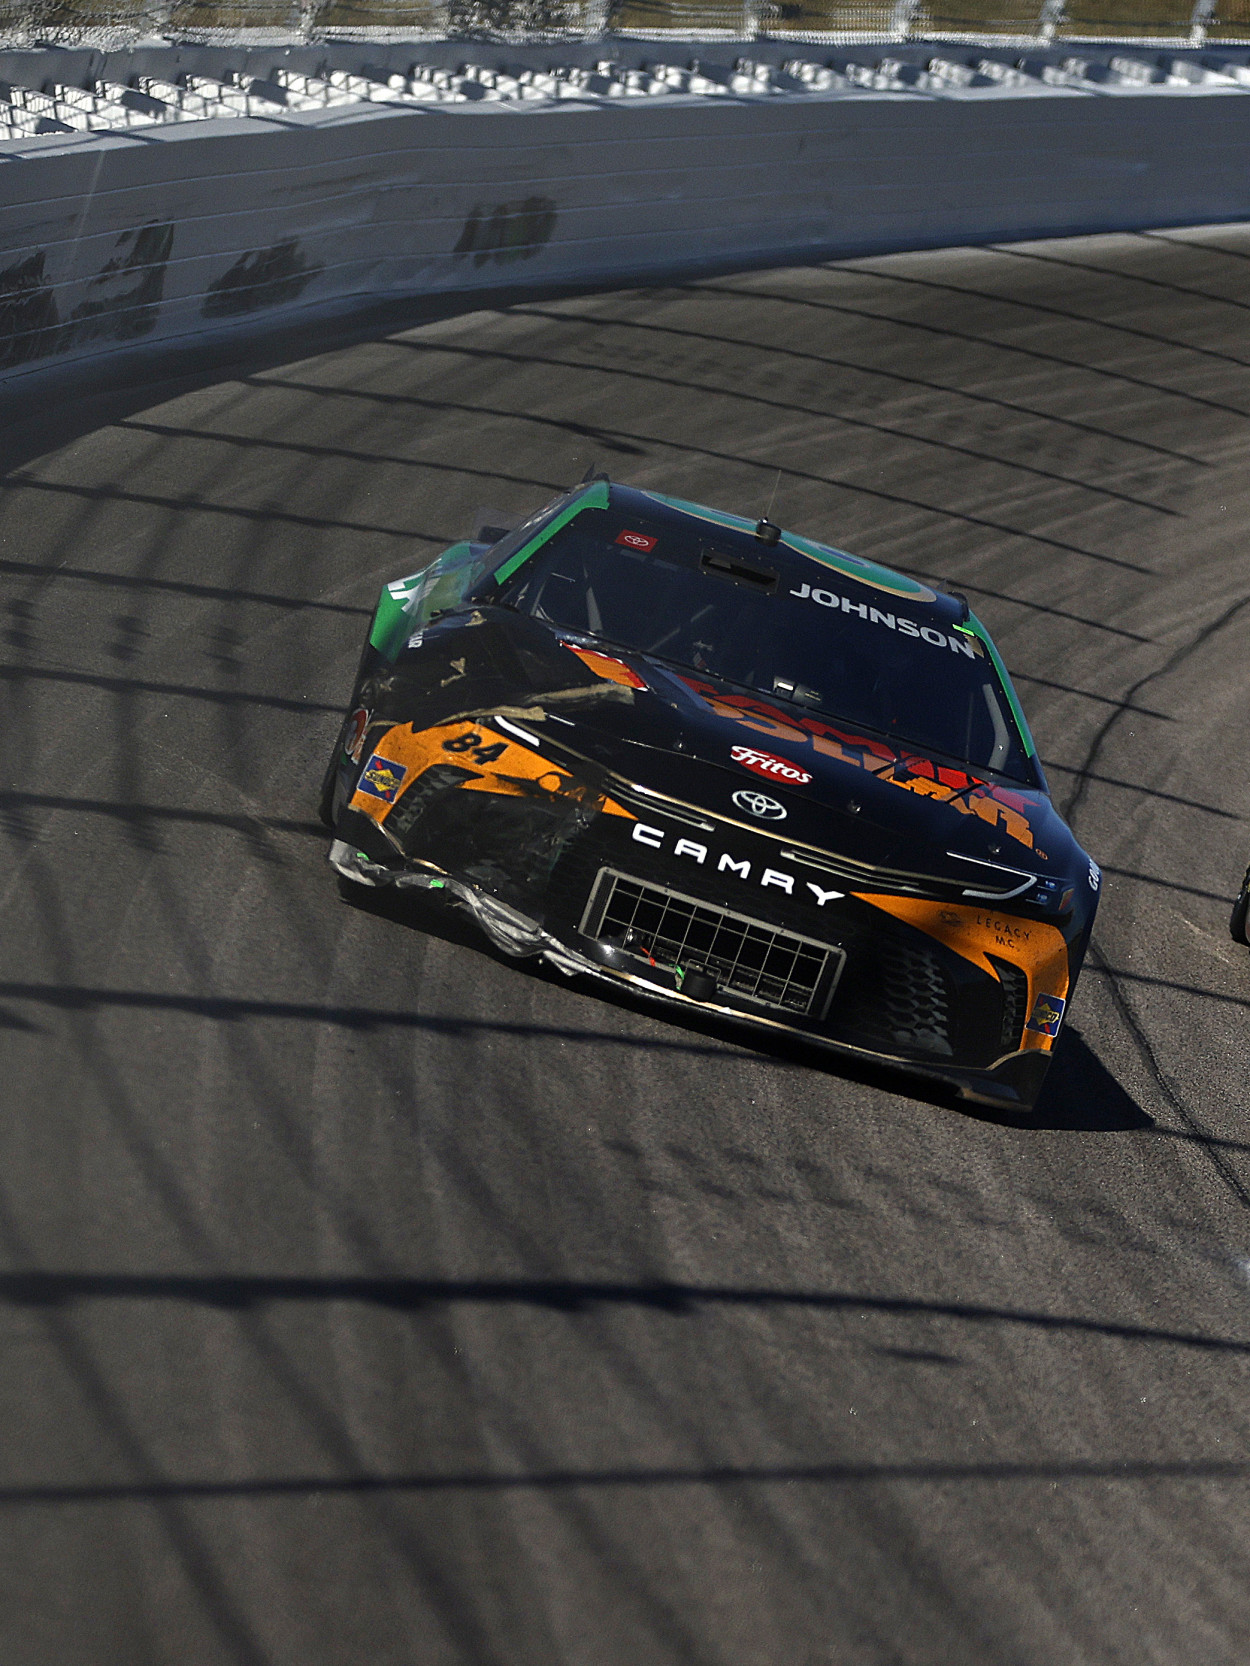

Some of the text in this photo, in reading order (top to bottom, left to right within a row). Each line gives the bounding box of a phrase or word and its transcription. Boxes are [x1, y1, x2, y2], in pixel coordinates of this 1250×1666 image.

[789, 582, 975, 660] JOHNSON
[441, 732, 509, 766] 84
[730, 745, 813, 784] Fritos
[631, 822, 846, 906] CAMRY
[976, 914, 1032, 941] LEGACY
